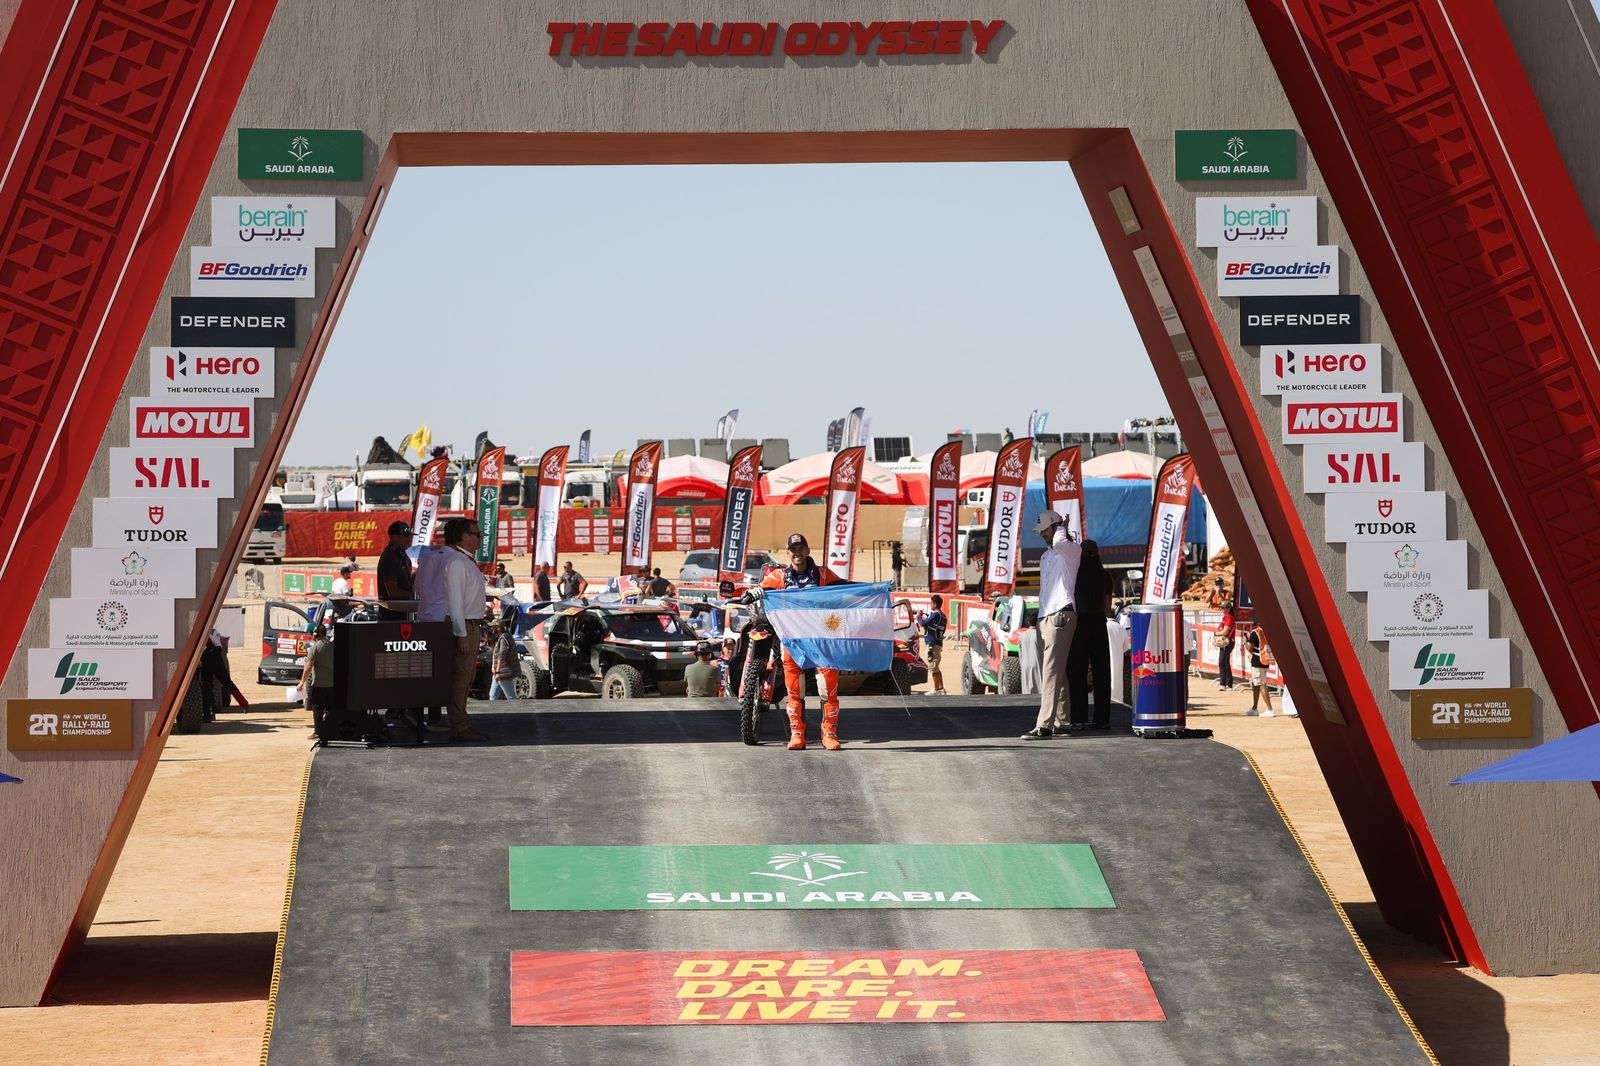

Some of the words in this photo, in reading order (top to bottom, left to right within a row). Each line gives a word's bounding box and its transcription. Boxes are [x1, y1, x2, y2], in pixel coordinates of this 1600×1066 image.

[546, 22, 633, 57] THE
[633, 22, 777, 57] SAUDI
[784, 19, 1006, 56] ODYSSEY
[264, 164, 295, 174] SAUDI
[297, 165, 335, 174] ARABIA
[1202, 165, 1231, 174] SAUDI
[1233, 165, 1270, 174] ARABIA
[239, 203, 305, 227] berain
[1224, 203, 1288, 227] berain
[239, 228, 305, 242] بيرين
[1224, 227, 1288, 242] بيرين
[199, 262, 308, 277] BFGoodrich
[1225, 262, 1331, 276] BFGoodrich
[180, 315, 286, 328] DEFENDER
[1248, 313, 1351, 327] DEFENDER
[1292, 383, 1338, 391] MOTORCYCLE
[141, 411, 245, 434] MOTUL
[1292, 406, 1393, 430] MOTUL
[135, 457, 210, 488] SAL
[1327, 453, 1401, 484] SAL
[1053, 481, 1077, 492] DAKAR
[1164, 484, 1188, 497] DAKAR
[334, 521, 378, 530] DREAM.
[417, 508, 432, 545] UDOR
[484, 507, 492, 534] ARABIA
[631, 489, 645, 559] BFGoodrich
[727, 491, 746, 569] DEFENDER
[937, 503, 953, 566] MOTUL
[996, 505, 1014, 563] TUDOR
[1355, 521, 1417, 535] TUDOR
[124, 529, 188, 542] TUDOR
[335, 541, 360, 550] LIVE
[482, 532, 491, 557] SAUDI
[1152, 512, 1175, 599] BFGoodrich
[1383, 581, 1405, 589] Ministry
[1413, 580, 1431, 588] Sport
[109, 588, 132, 596] Ministry
[140, 588, 158, 596] Sport
[384, 640, 427, 652] TUDOR
[1143, 649, 1170, 665] Bull
[1464, 709, 1510, 717] RALLY-RAID
[1464, 716, 1512, 724] CHAMPIONSHIP
[62, 720, 111, 728] RALLY-RAID
[62, 728, 112, 736] CHAMPIONSHIP
[646, 892, 787, 904] SAUDI
[802, 891, 982, 904] ARABIA
[672, 959, 983, 978] DREAM.
[675, 979, 914, 998] DARE.
[678, 1000, 870, 1020] LIVE
[877, 1000, 967, 1020] IT.
